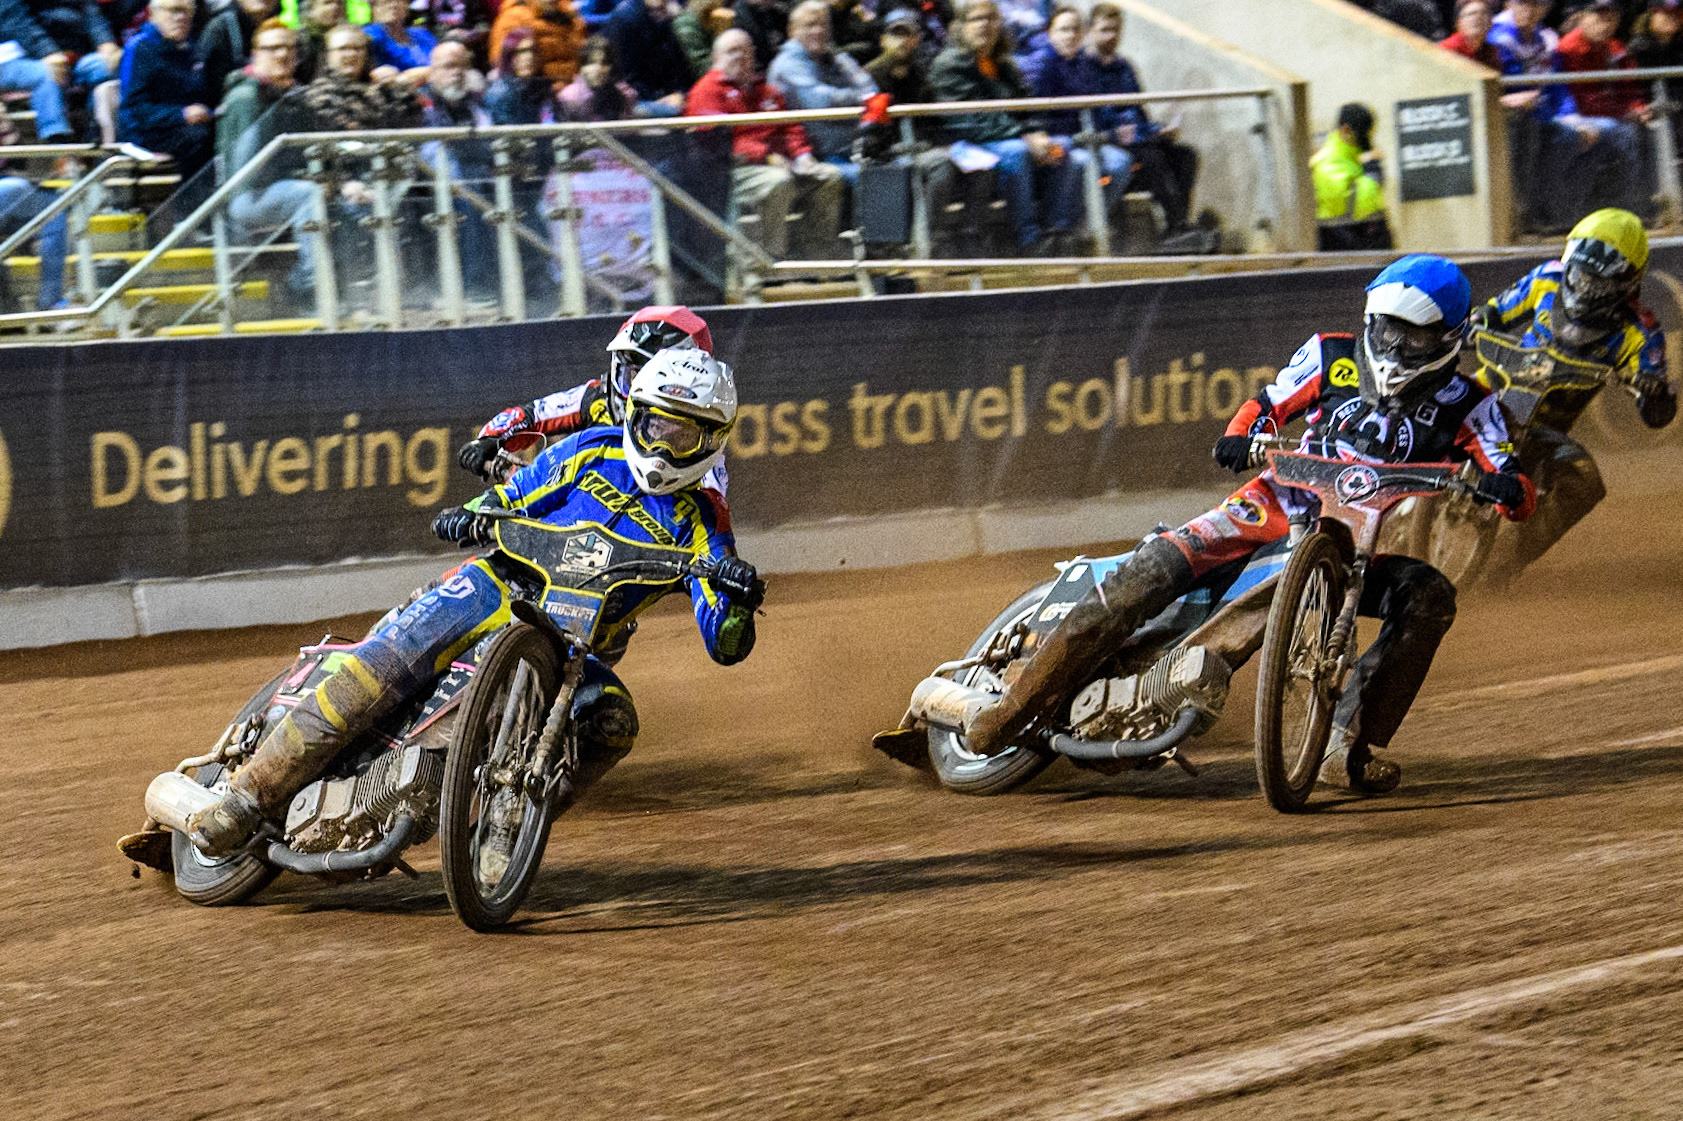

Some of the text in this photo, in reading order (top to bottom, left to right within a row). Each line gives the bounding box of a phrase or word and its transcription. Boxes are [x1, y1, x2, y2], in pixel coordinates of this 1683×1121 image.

[92, 351, 1278, 508] Delivering ass travel solution
